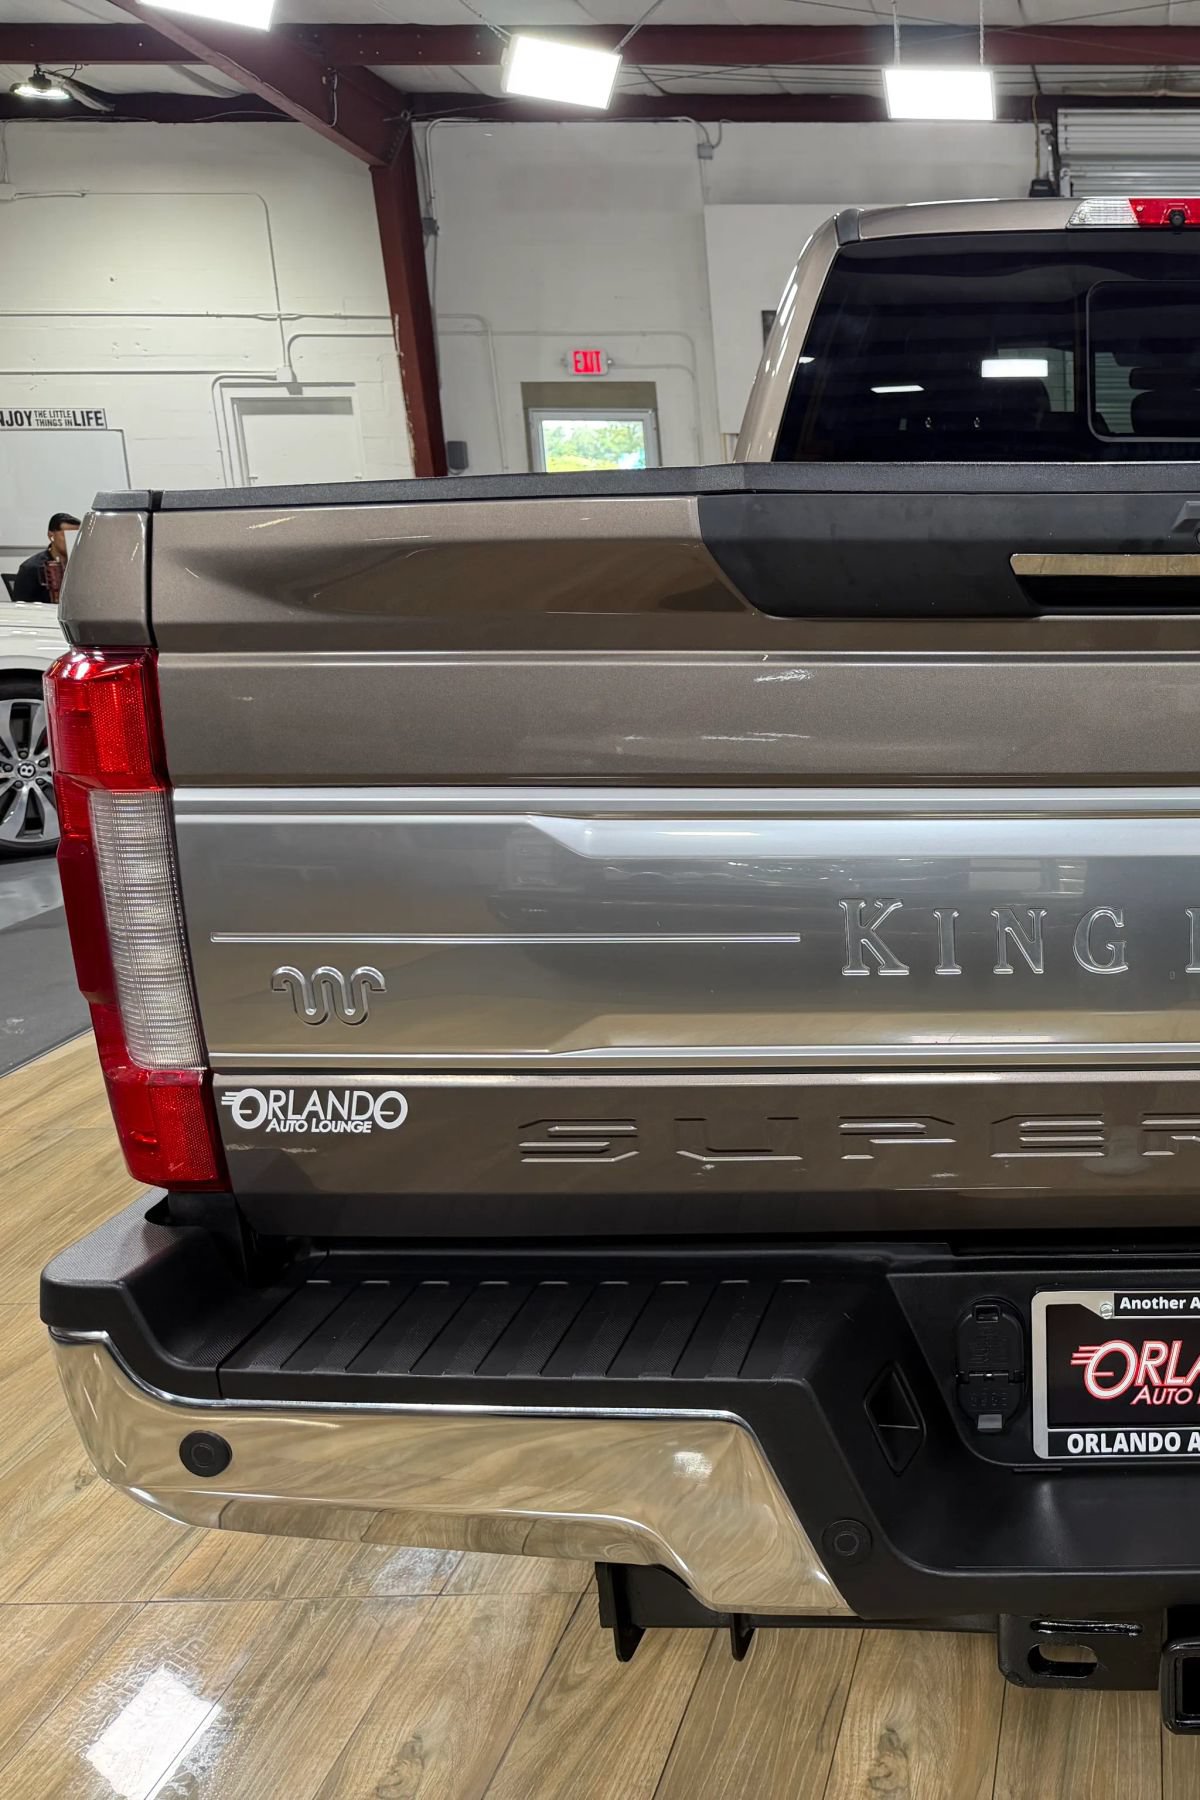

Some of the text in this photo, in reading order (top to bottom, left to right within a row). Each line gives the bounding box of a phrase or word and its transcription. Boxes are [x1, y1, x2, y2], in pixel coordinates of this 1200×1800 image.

[574, 351, 601, 373] EXIT
[33, 410, 72, 418] THE LITTLE
[35, 419, 73, 427] THINGS IN
[72, 410, 104, 427] LIFE
[840, 897, 1130, 976] KING
[230, 1088, 409, 1130] ORLANDO
[265, 1118, 373, 1133] AUTO LOUNGE
[1120, 1297, 1190, 1310] Another
[1130, 1385, 1194, 1405] AUTO
[1067, 1431, 1182, 1454] ORLANDO
